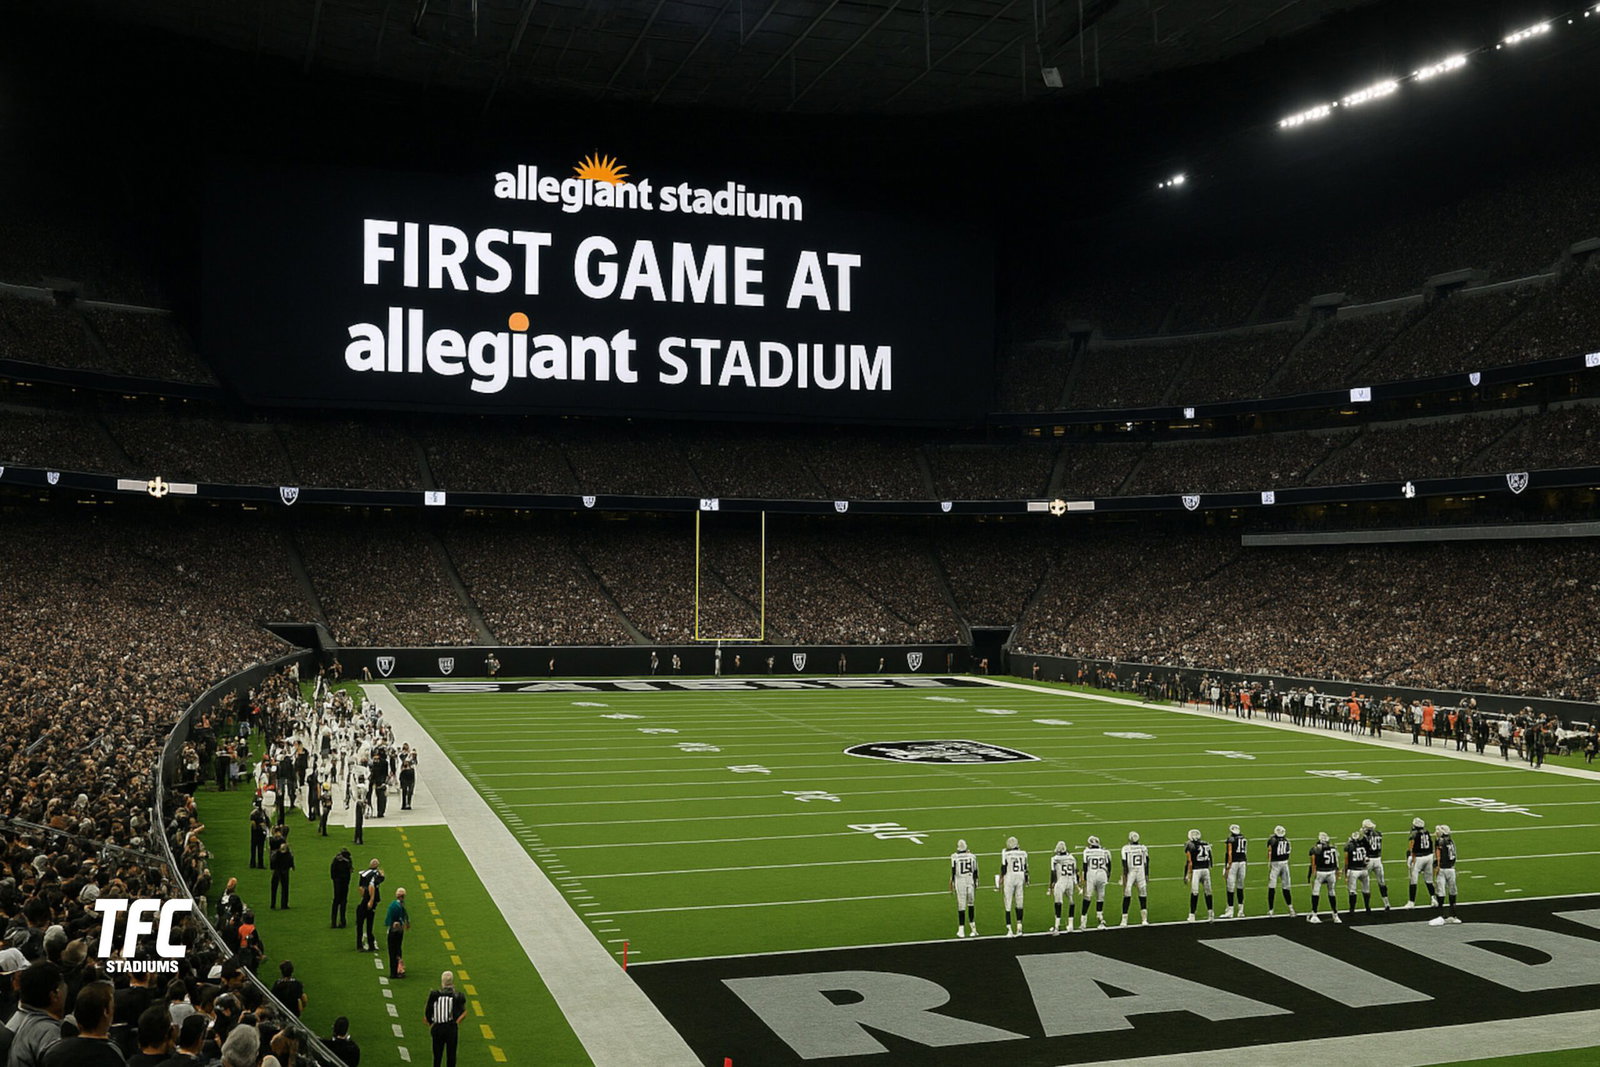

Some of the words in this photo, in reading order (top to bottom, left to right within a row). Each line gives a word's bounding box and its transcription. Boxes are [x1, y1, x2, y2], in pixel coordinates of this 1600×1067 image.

[494, 164, 653, 213] allegiant
[659, 180, 803, 221] stadium
[363, 218, 552, 295] FIRST
[574, 235, 765, 307] GAME
[786, 250, 862, 312] AT
[344, 306, 638, 394] allegiant
[658, 336, 892, 391] STADIUM
[1061, 862, 1075, 877] 59
[1090, 857, 1107, 871] 92
[721, 908, 1600, 1060] RAID
